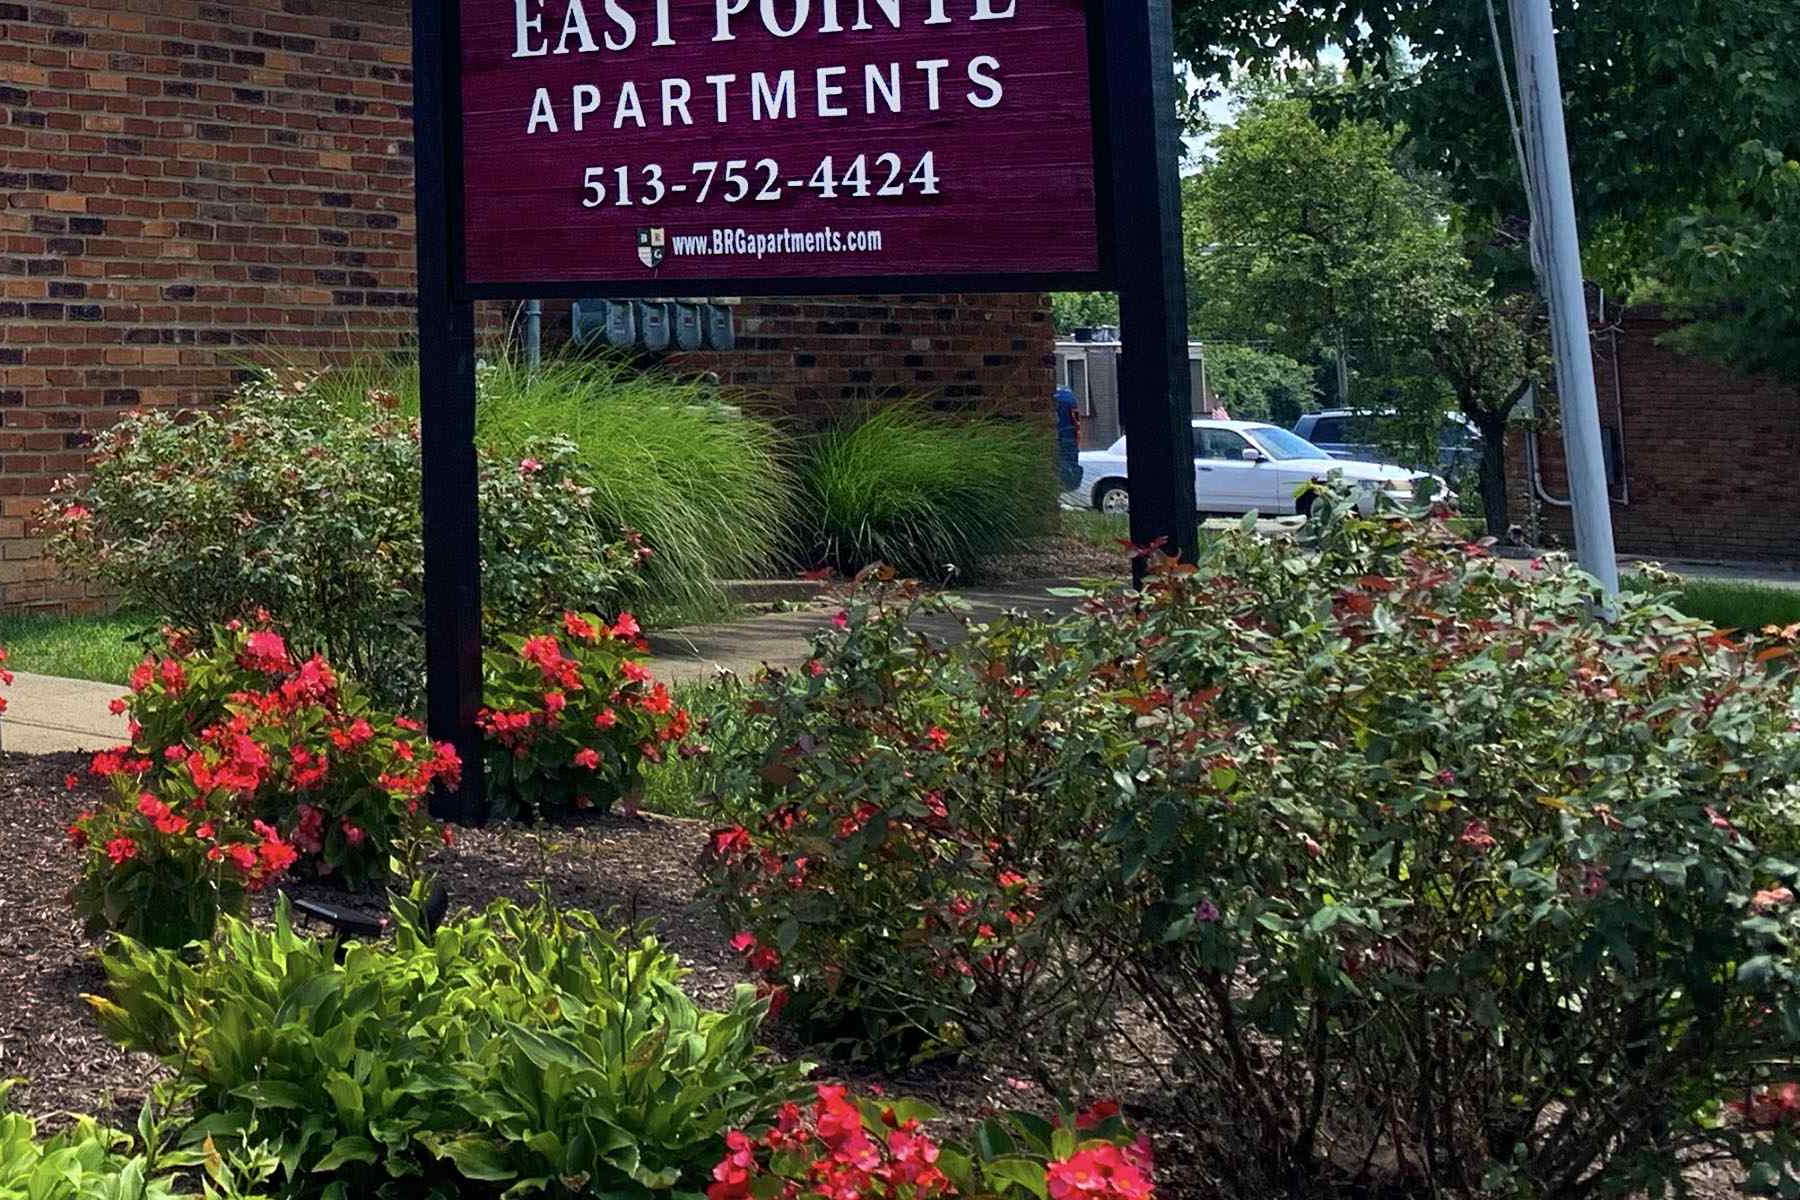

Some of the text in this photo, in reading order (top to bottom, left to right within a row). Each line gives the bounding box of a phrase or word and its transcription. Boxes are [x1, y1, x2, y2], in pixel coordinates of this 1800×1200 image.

[526, 55, 1004, 134] APARTMENTS
[582, 150, 940, 208] 513-752-4424
[672, 226, 883, 260] www.BRGapartments.com
